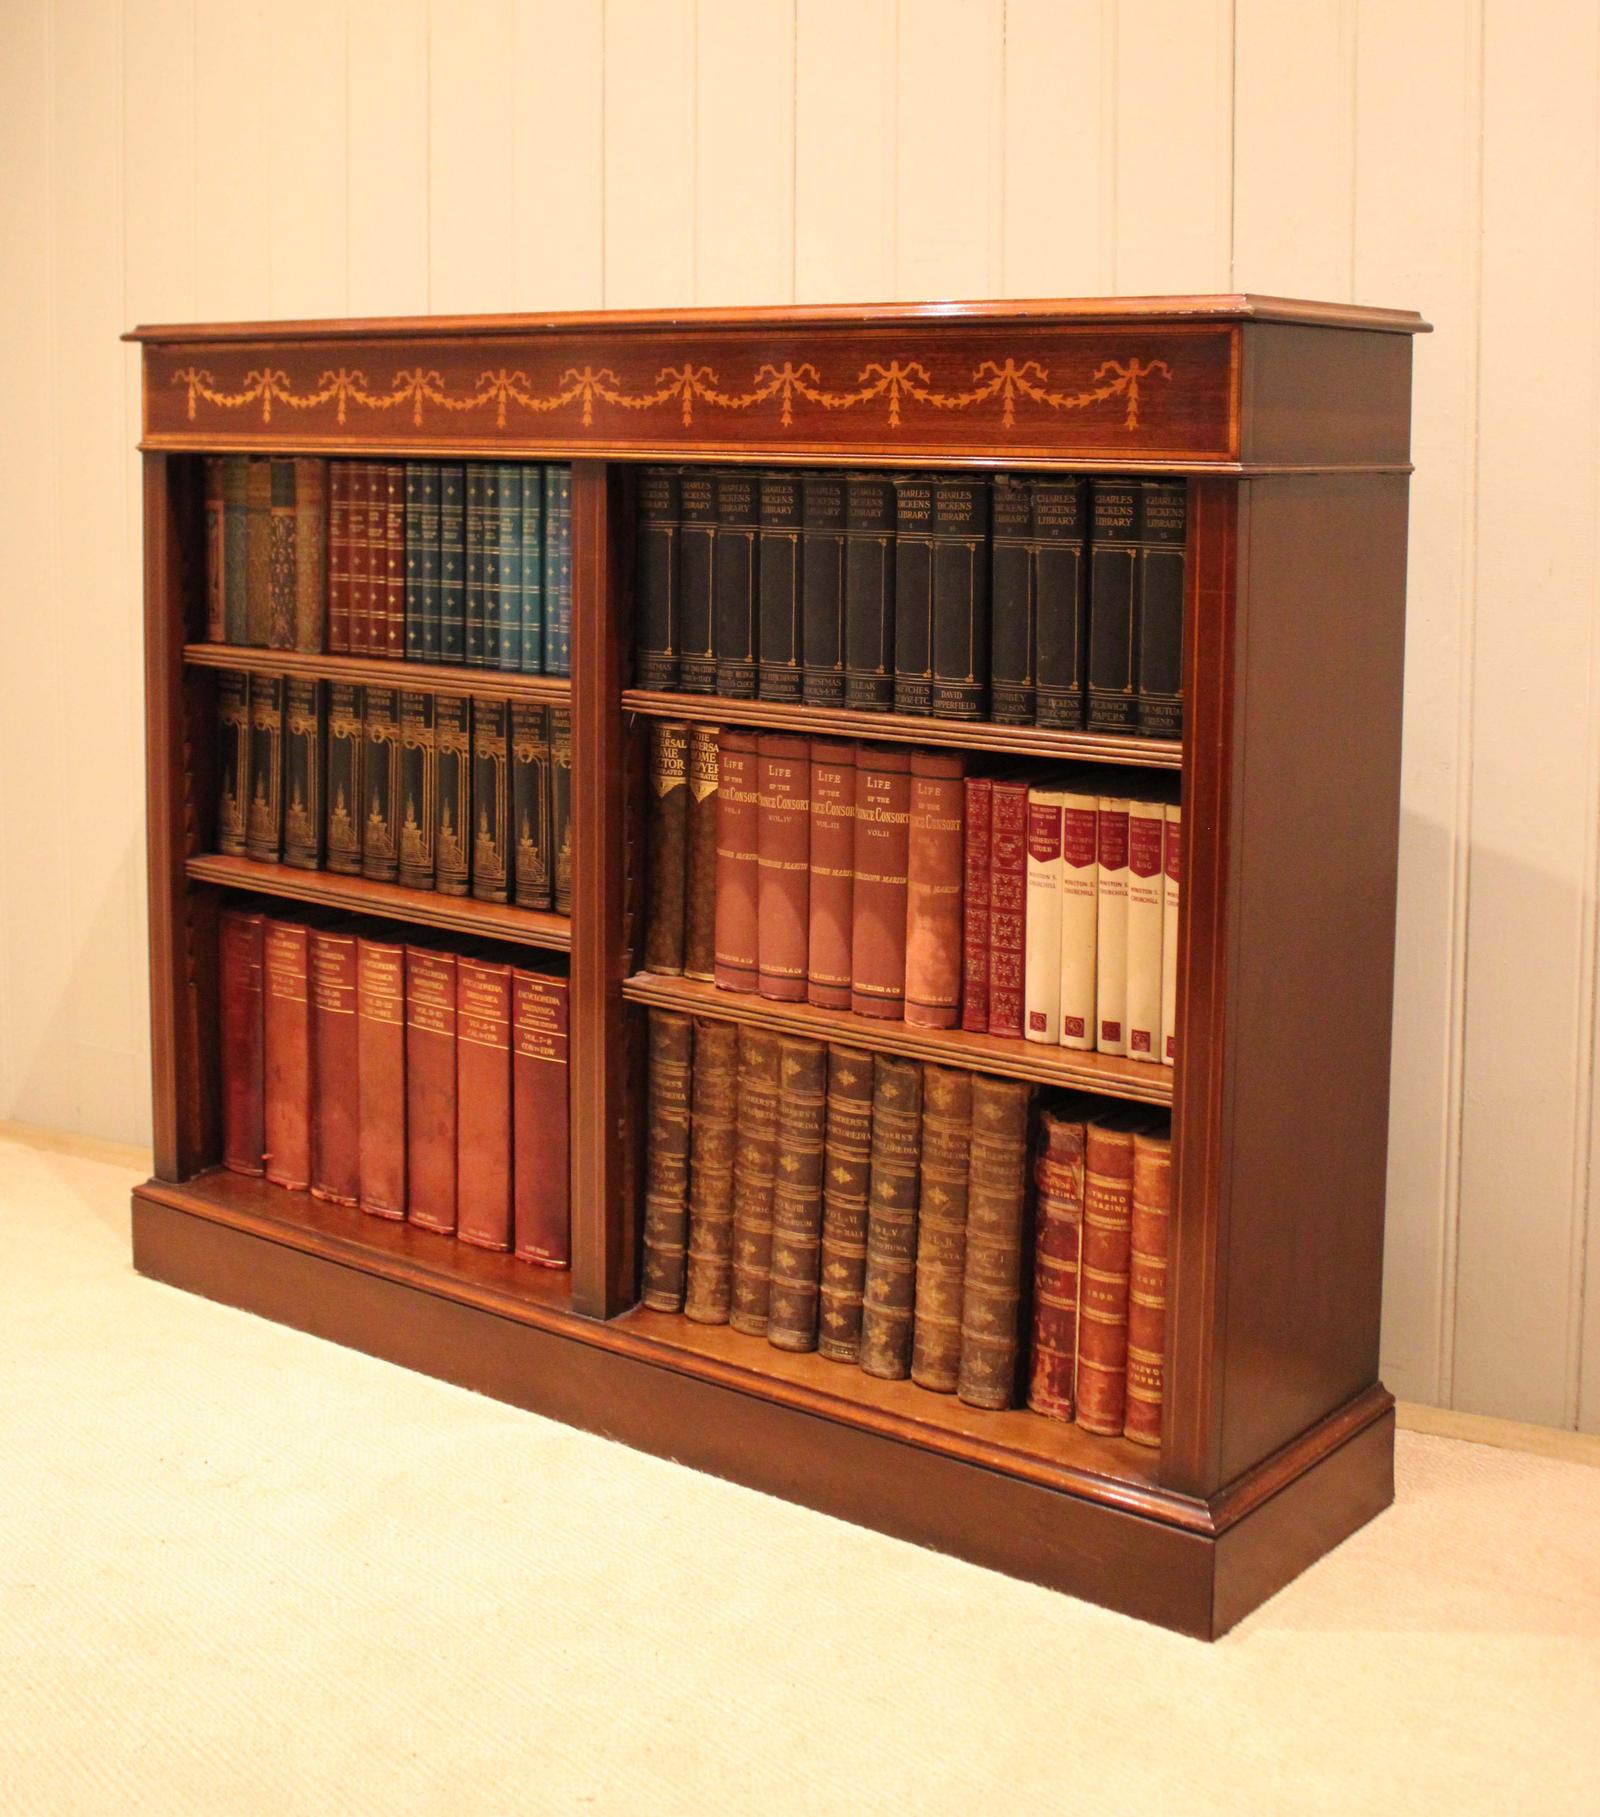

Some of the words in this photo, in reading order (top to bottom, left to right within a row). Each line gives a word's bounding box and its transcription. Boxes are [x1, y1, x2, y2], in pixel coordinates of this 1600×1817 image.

[897, 489, 930, 498] CHARLES
[936, 491, 972, 500] CHARLES
[1037, 494, 1077, 504] CHARLES
[1095, 495, 1133, 504] CHARLES
[897, 500, 931, 509] DICKENS
[937, 501, 973, 510] DICKENS
[1038, 505, 1077, 514] DICKENS
[1095, 506, 1133, 515] DICKENS
[1146, 508, 1184, 517] DICKENS
[897, 510, 930, 520] LIBRARY
[937, 512, 972, 521] LIBRARY
[1038, 516, 1077, 526] LIBRARY
[1095, 517, 1133, 527] LIBRARY
[1147, 519, 1184, 528] LIBRARY
[940, 690, 963, 700] DAVID
[1091, 711, 1126, 722] PAPERS
[723, 756, 744, 770] LIFE
[768, 764, 791, 778] LIFE
[818, 769, 841, 783] LIFE
[867, 776, 892, 790] LIFE
[918, 783, 942, 796] LIFE
[776, 794, 809, 811] CONSORT
[876, 796, 890, 804] THE
[927, 803, 940, 811] THE
[875, 807, 910, 824] CONSORT
[1036, 828, 1048, 836] THE
[1029, 835, 1059, 846] GATHERING
[882, 876, 907, 885] MARTIN
[531, 984, 544, 992] THE
